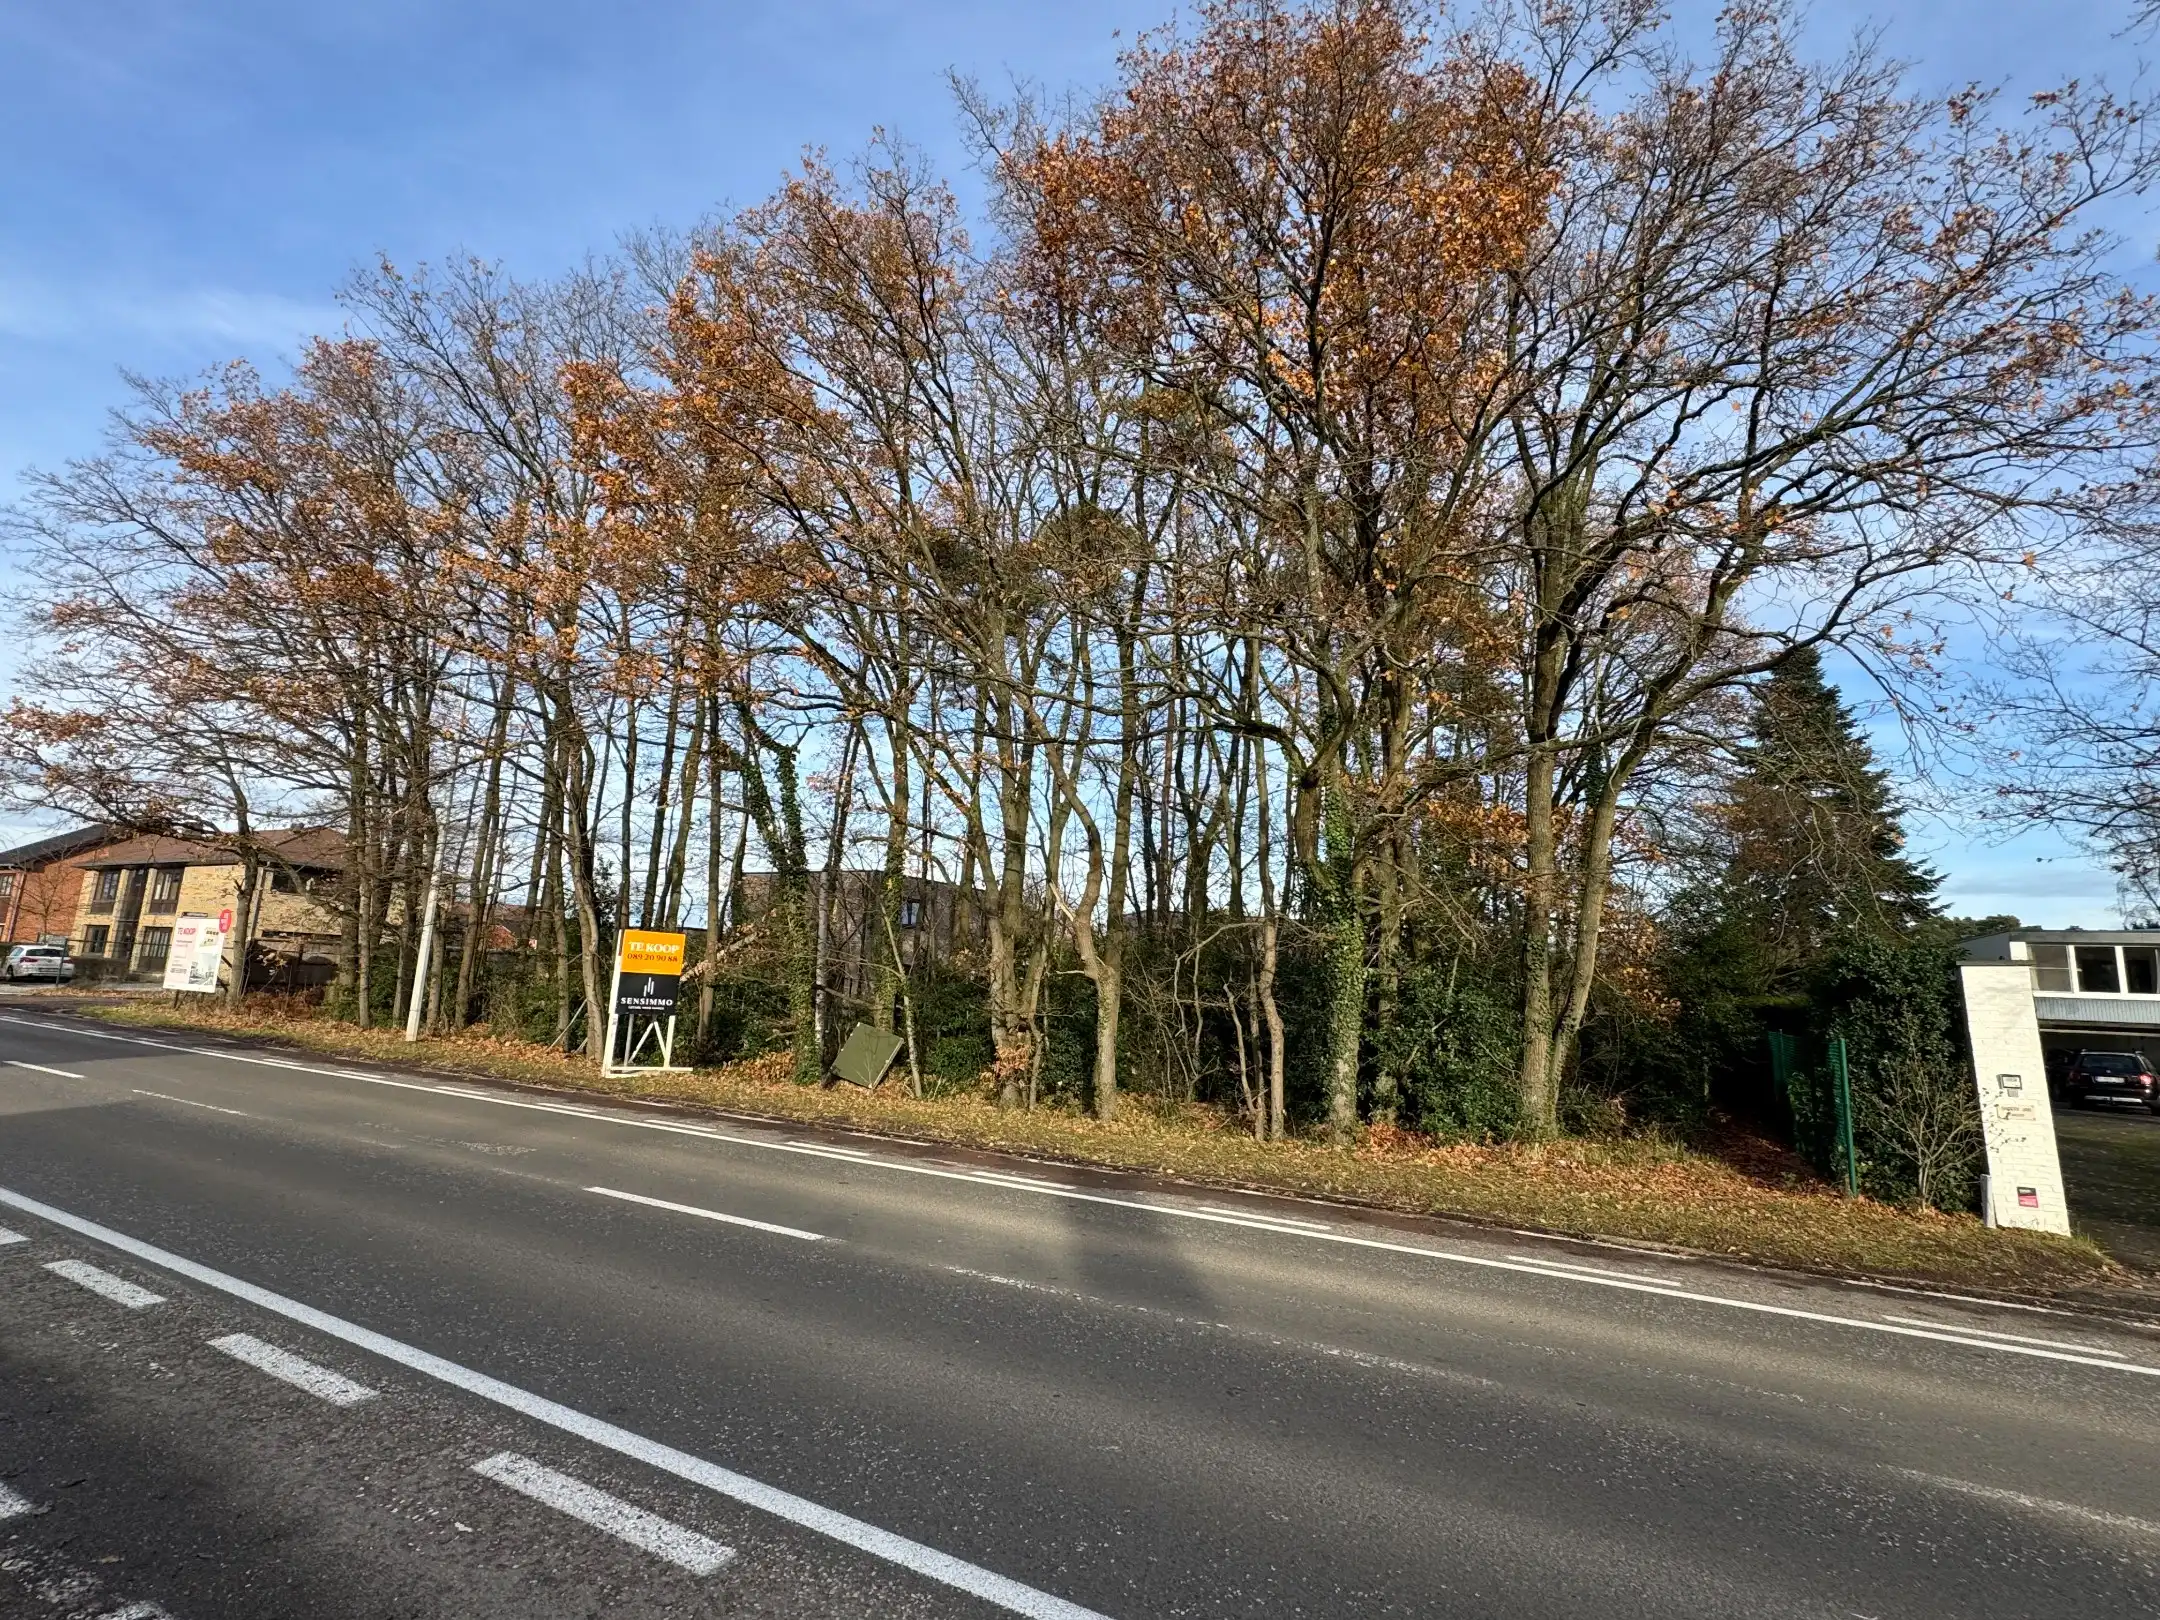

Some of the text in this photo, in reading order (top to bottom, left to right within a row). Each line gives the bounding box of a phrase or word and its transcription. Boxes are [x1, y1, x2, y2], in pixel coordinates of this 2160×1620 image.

[628, 941, 680, 954] TE KOOP
[620, 997, 673, 1006] SENSIMMO
